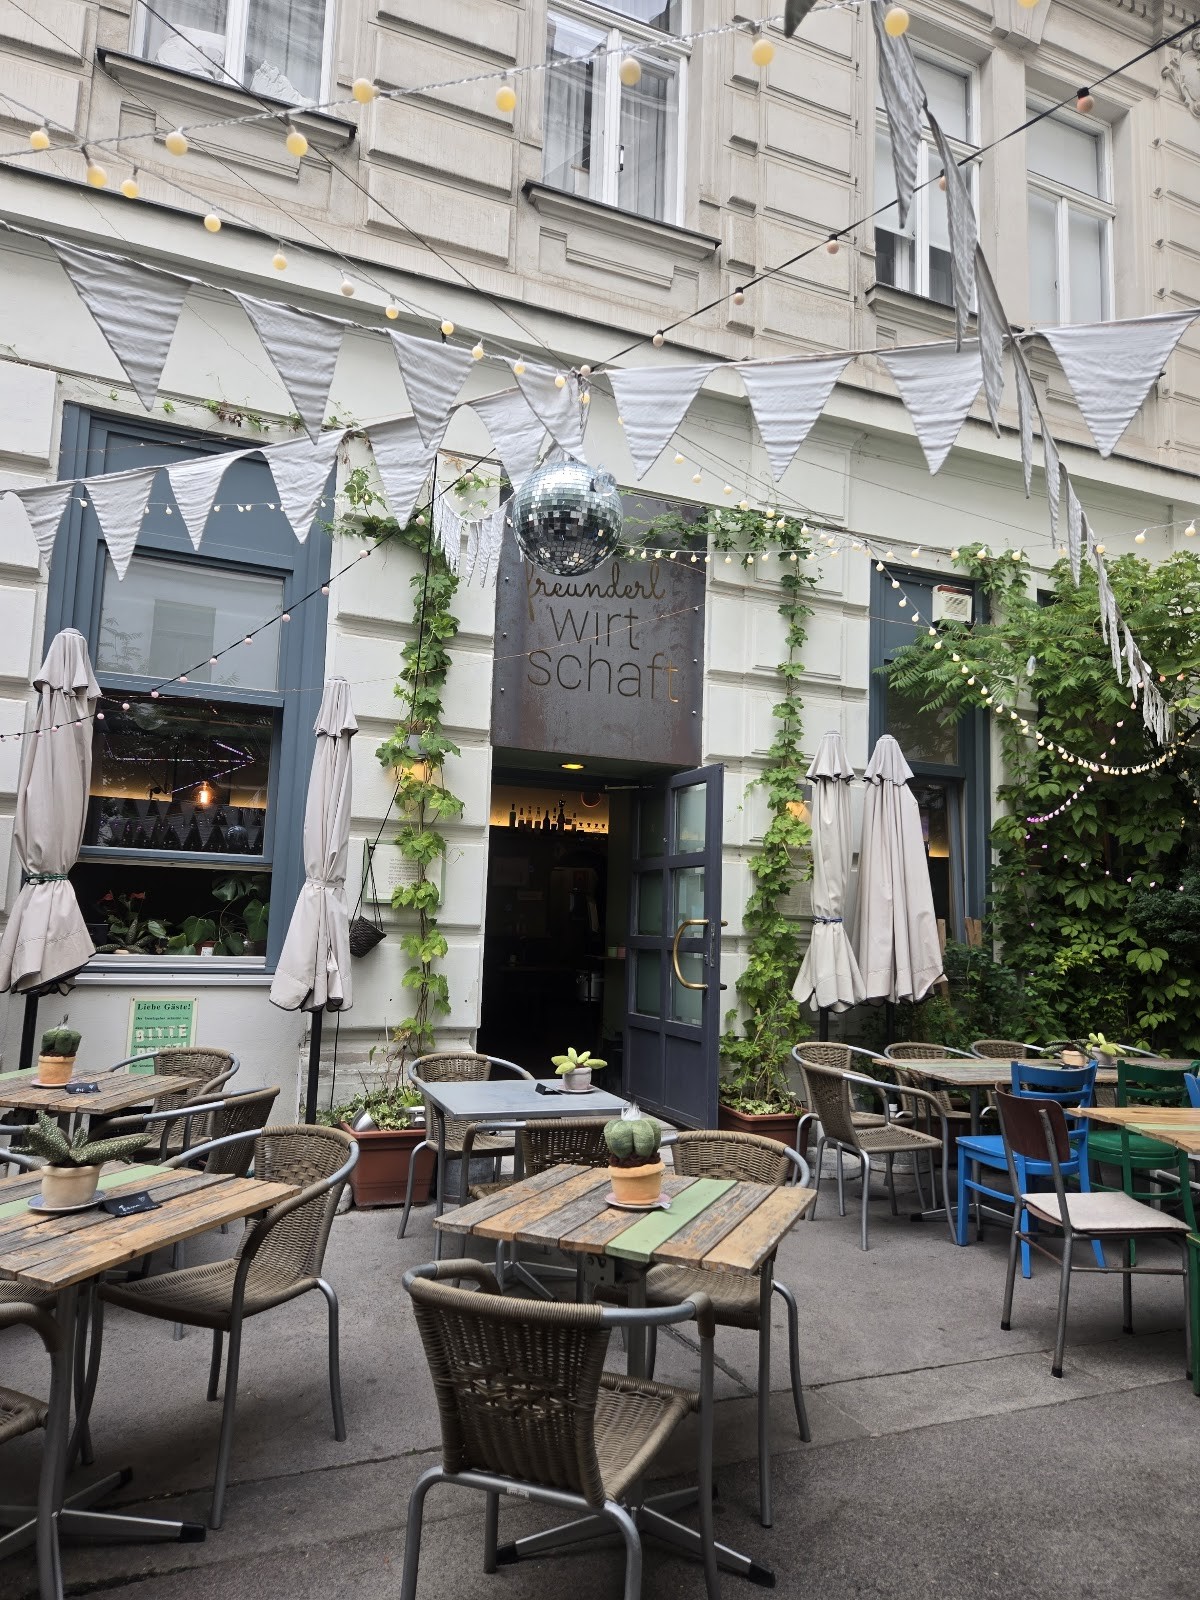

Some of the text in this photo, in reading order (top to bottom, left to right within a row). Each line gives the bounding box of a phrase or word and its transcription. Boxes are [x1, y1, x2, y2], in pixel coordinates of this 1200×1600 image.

[527, 644, 679, 703] schaft
[137, 1003, 191, 1011] Liebe Gäste!
